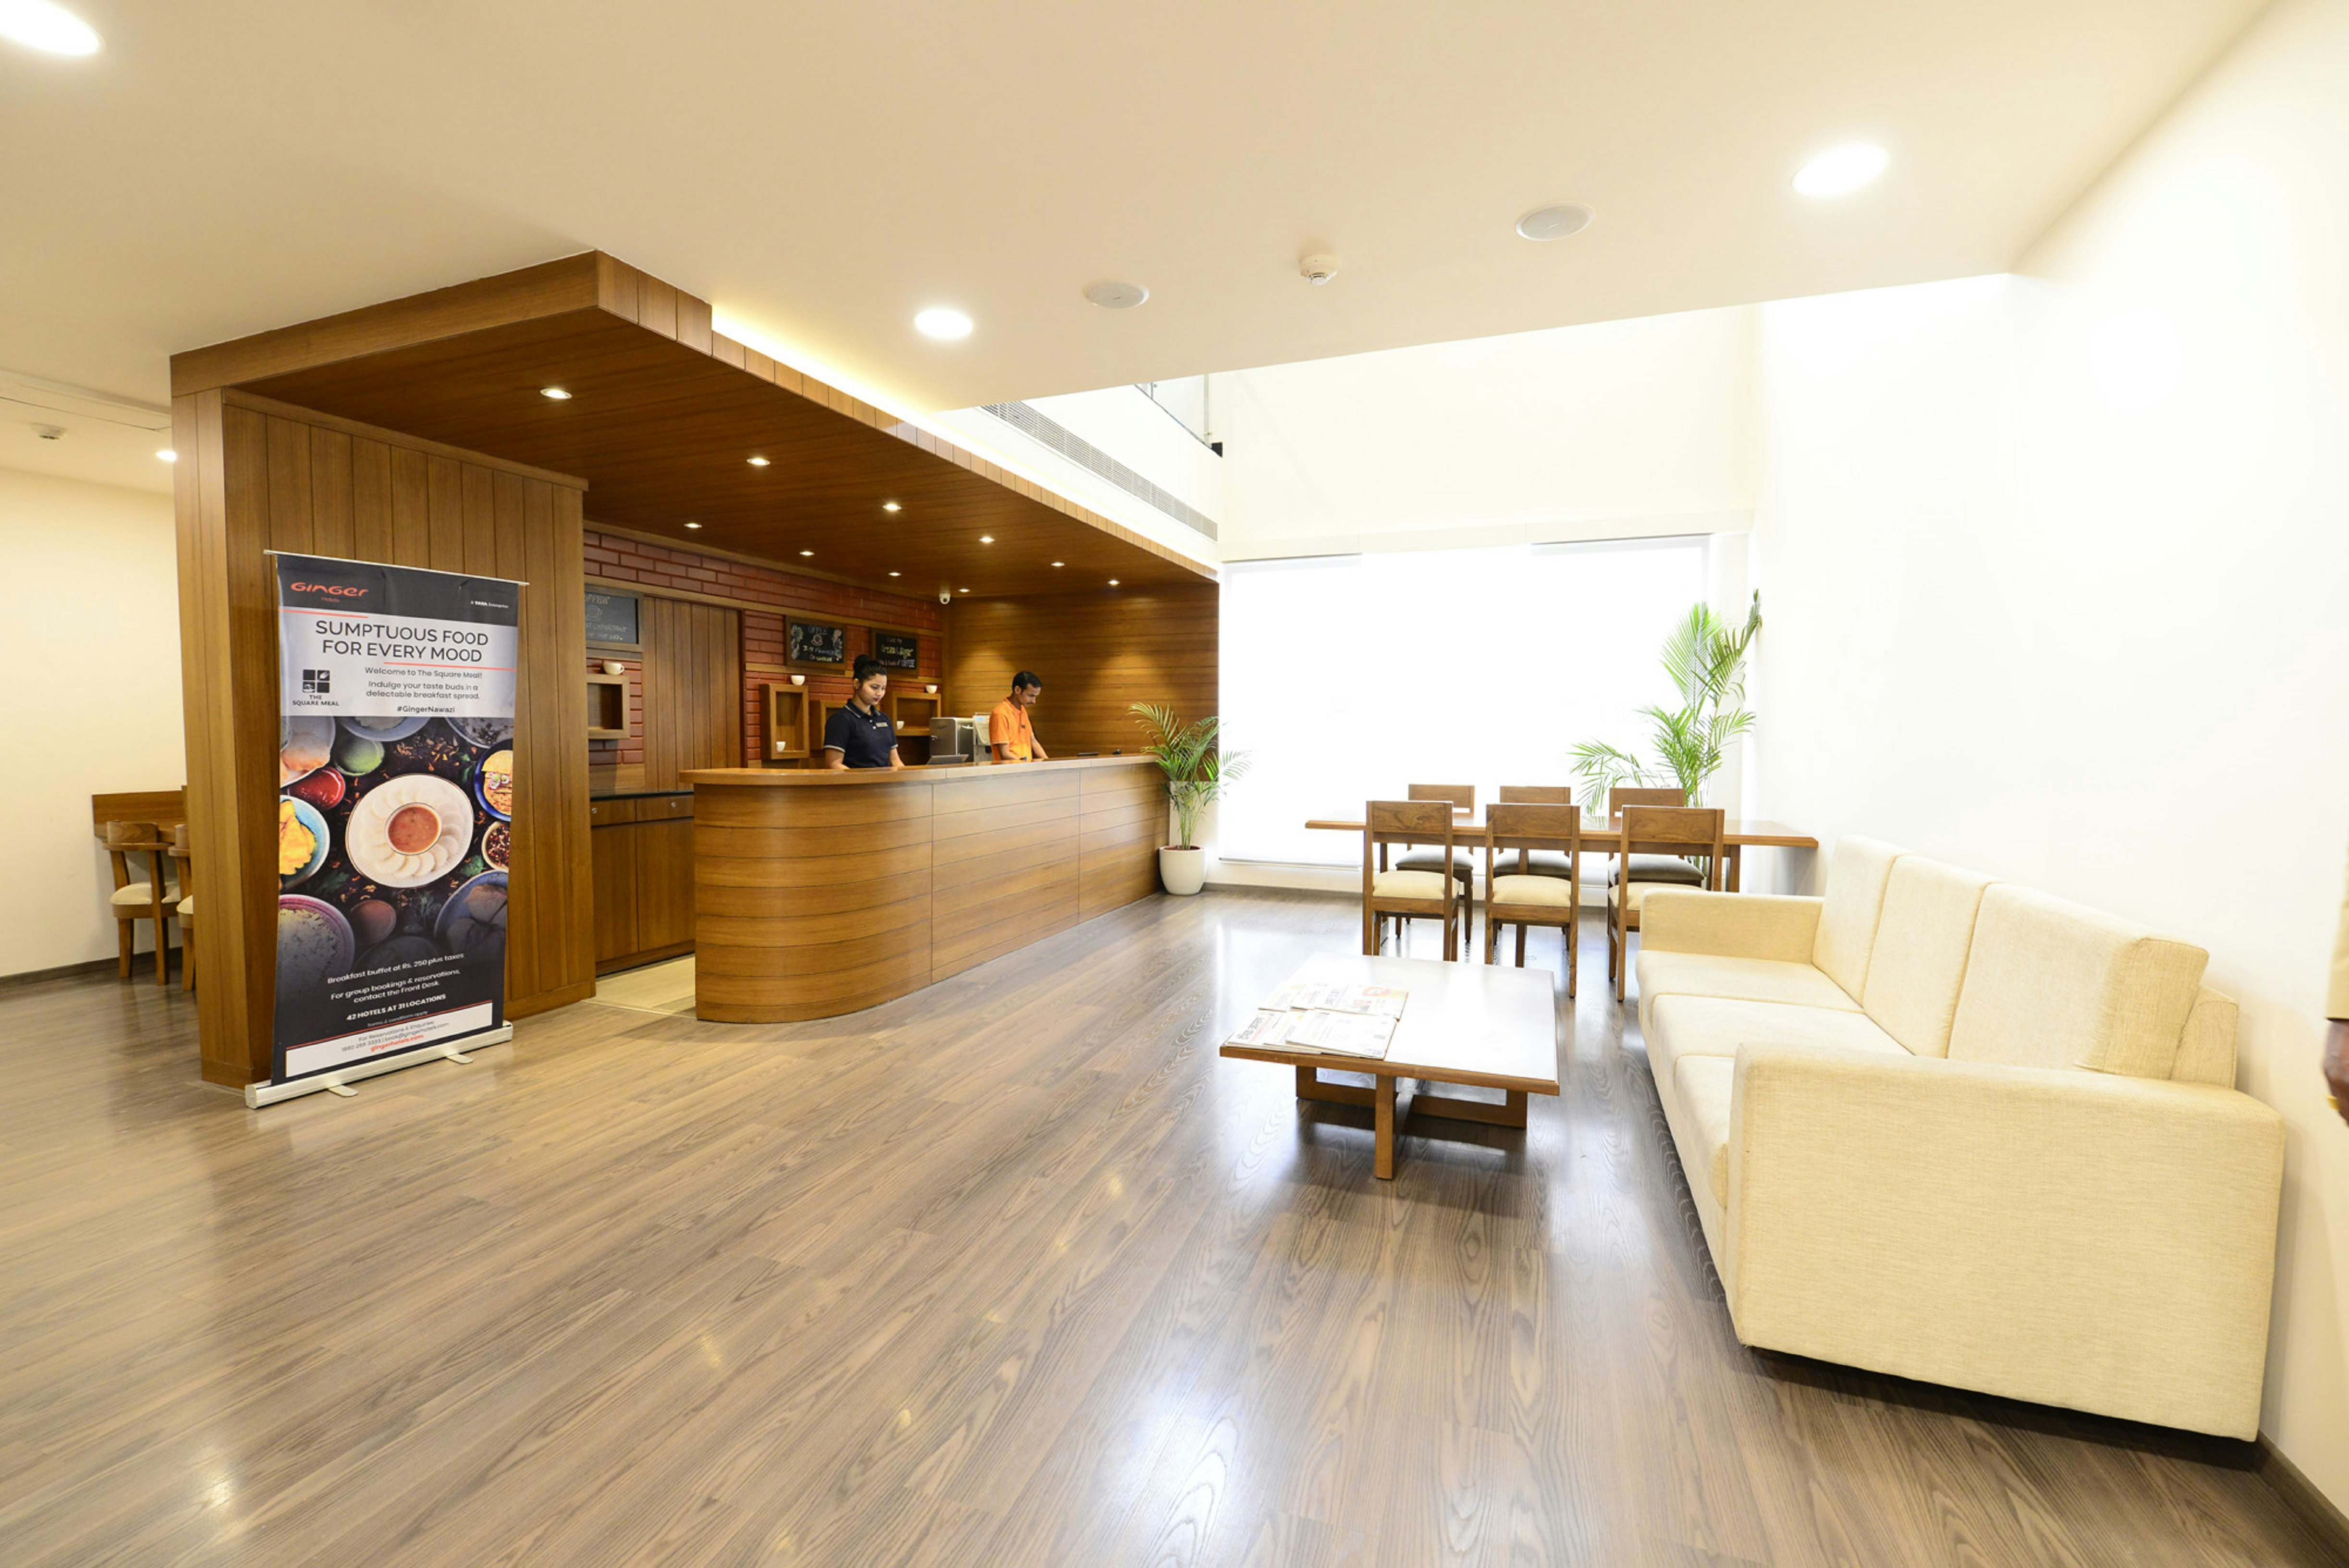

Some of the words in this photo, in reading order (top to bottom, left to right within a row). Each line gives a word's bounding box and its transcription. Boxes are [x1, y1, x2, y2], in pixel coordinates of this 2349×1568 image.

[316, 620, 438, 642] SUMPTUOUS
[443, 630, 488, 645] FOOD
[323, 639, 362, 655] FOR
[367, 643, 426, 659] EVERY
[431, 647, 482, 662] MOOD
[365, 667, 405, 675] Welcome
[368, 681, 401, 689] Indulge
[328, 971, 365, 984] Breakfast
[367, 967, 391, 976] buffet
[428, 957, 443, 966] plus
[444, 953, 464, 961] taxes
[345, 987, 370, 998] group
[371, 980, 406, 991] bookings
[354, 992, 385, 1003] contact
[401, 984, 420, 993] Front
[357, 1007, 386, 1018] HOTELS
[406, 993, 446, 1008] LOCATIONS
[368, 1028, 404, 1039] Reservations
[370, 1035, 424, 1052] gingerhotels.com
